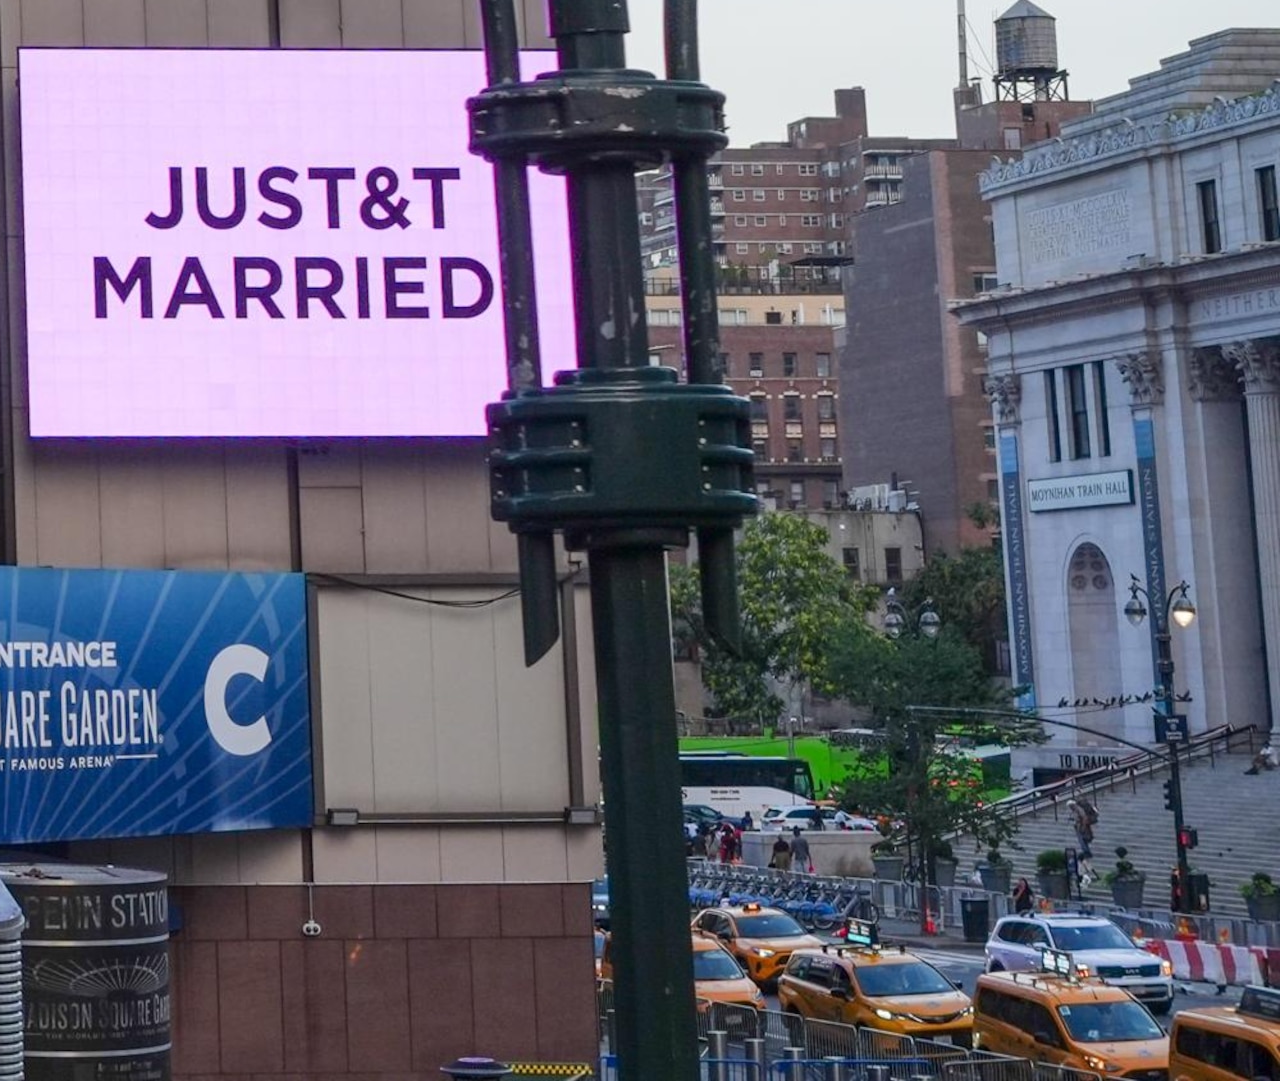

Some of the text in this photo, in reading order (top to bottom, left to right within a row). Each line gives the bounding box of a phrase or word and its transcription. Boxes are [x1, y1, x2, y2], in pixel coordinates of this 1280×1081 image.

[144, 166, 461, 230] JUST&T
[1201, 289, 1280, 320] NEITHER
[1031, 480, 1127, 502] MOYNIHAN TRAIN HALL
[1007, 480, 1030, 675] MOYNIHAN TRAIN HALL
[204, 643, 273, 756] C
[11, 757, 65, 771] FAMOUS
[1058, 754, 1117, 769] TO TRAINS
[26, 1001, 92, 1030] ADISON
